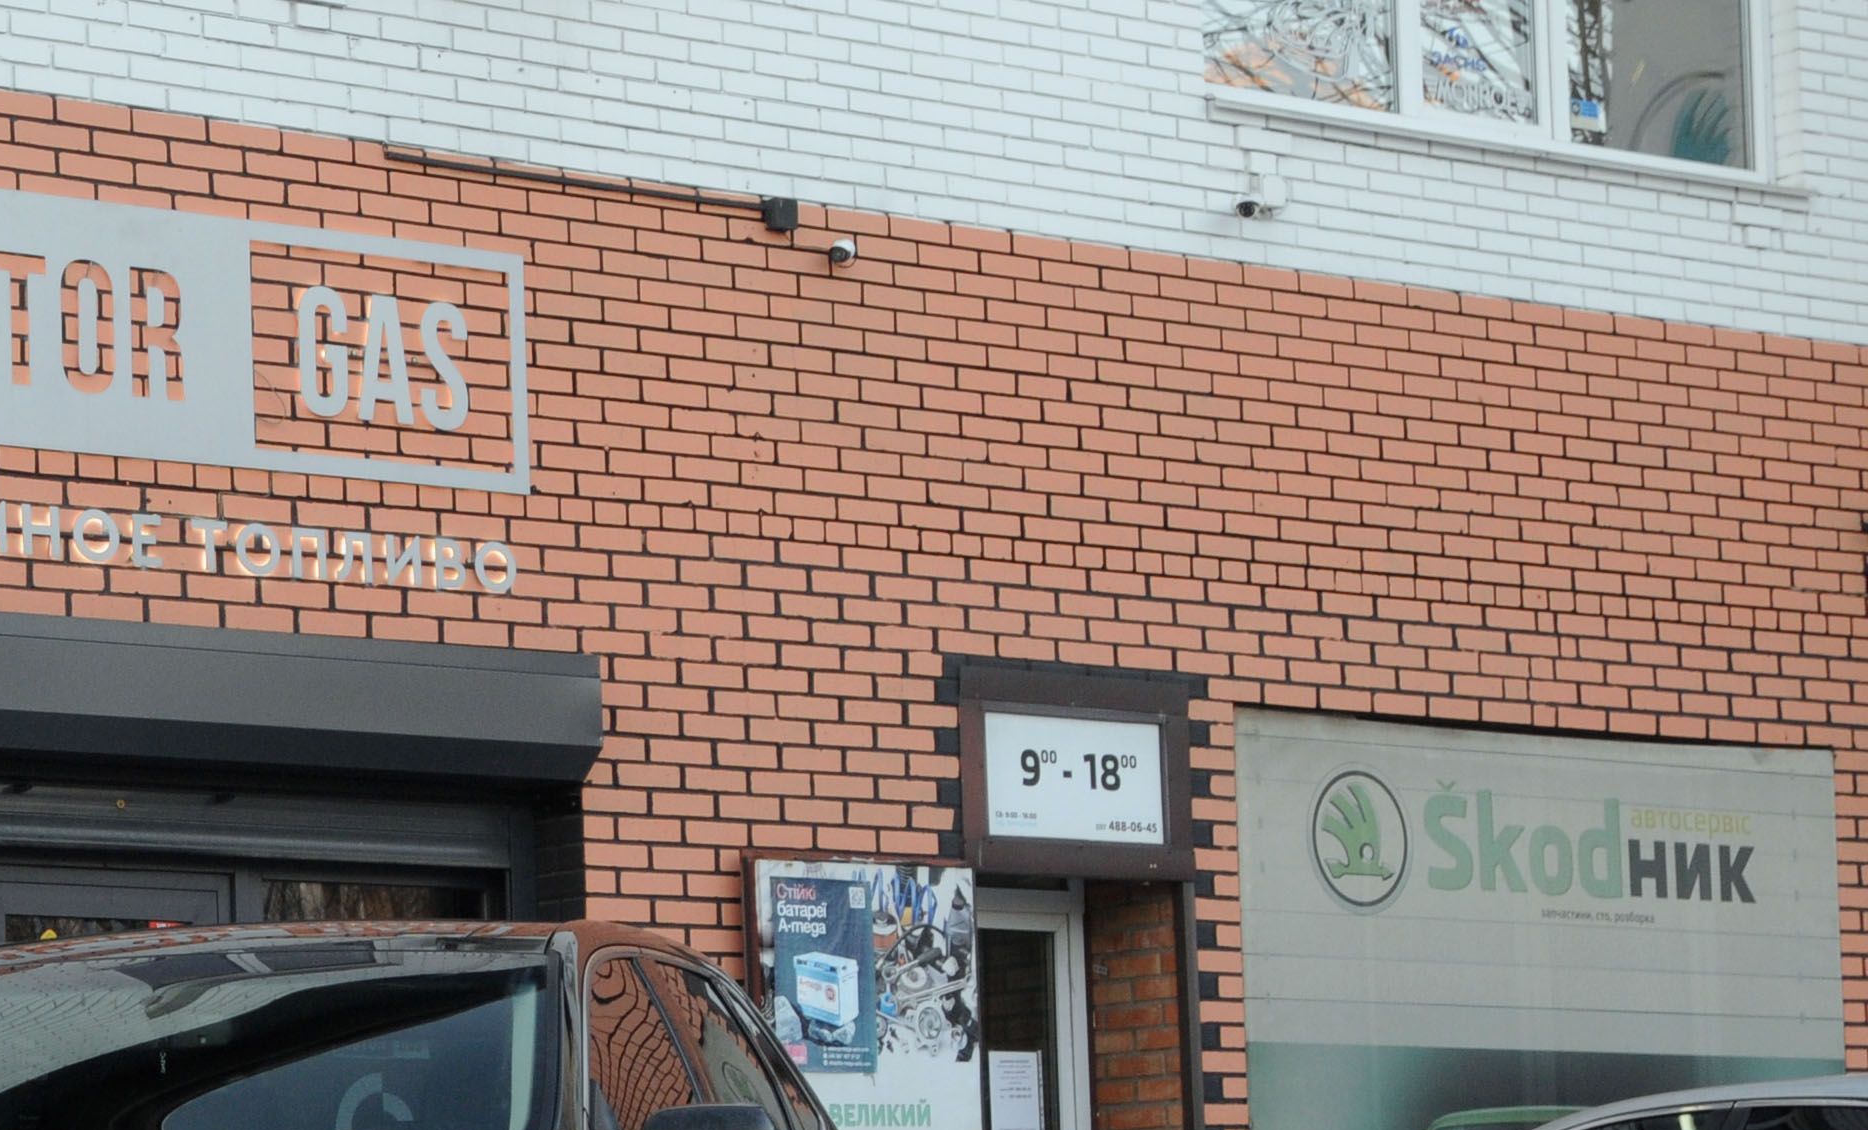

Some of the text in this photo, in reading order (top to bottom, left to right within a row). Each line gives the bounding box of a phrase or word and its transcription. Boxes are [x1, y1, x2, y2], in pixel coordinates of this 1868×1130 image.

[298, 285, 470, 432] GAS
[192, 518, 518, 595] ТОПЛИВО
[1632, 808, 1752, 840] автосервіс
[776, 901, 827, 921] батареї
[829, 1098, 932, 1127] ВЕЛИКИЙ
